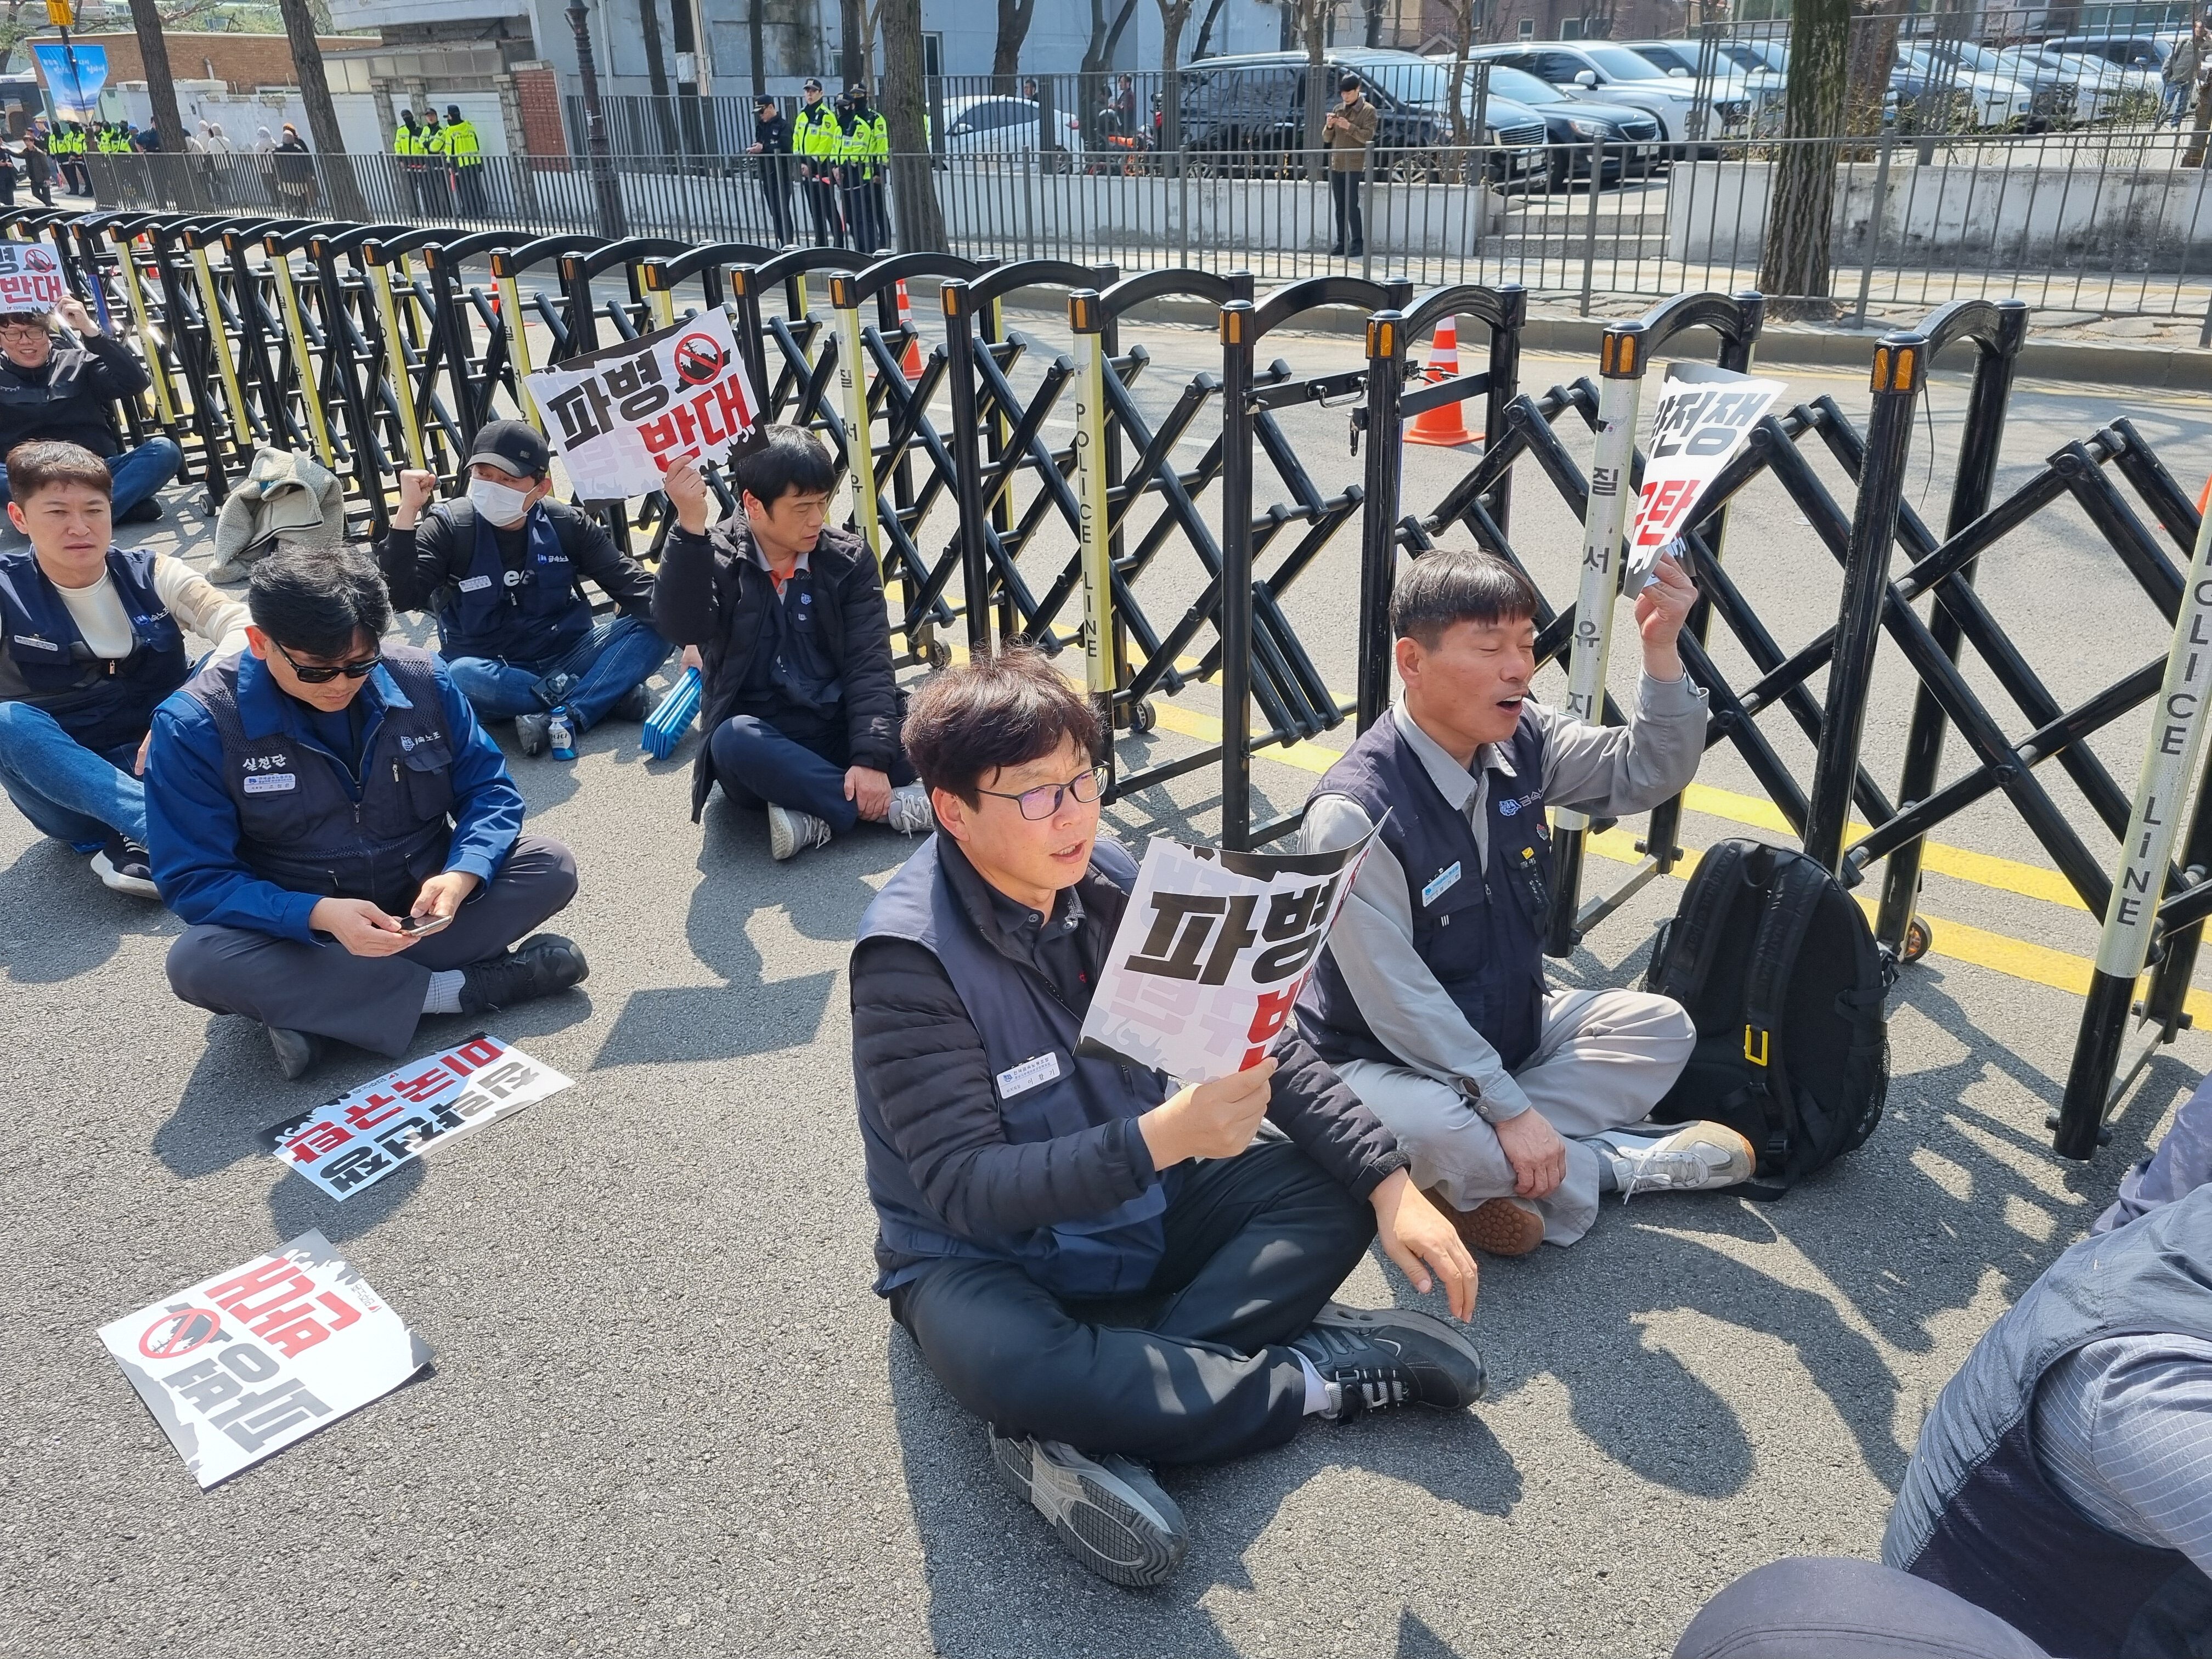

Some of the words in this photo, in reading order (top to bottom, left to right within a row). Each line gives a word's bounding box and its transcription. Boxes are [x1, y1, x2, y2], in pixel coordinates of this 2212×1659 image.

[0, 275, 63, 303] 반대
[546, 348, 669, 452] 파병
[636, 373, 752, 473] 반대
[1076, 403, 1092, 544] POLICE
[1084, 571, 1098, 658] LINE
[242, 754, 287, 771] 실천단
[415, 731, 441, 746] 속노조
[2117, 796, 2162, 927] LINE
[1124, 871, 1341, 986] 파병
[284, 1038, 506, 1165] 미국규탄
[319, 1061, 541, 1194] 침략전쟁
[203, 1256, 362, 1360] 반대
[351, 1283, 375, 1308] 민주노총
[162, 1343, 334, 1454] 파병
